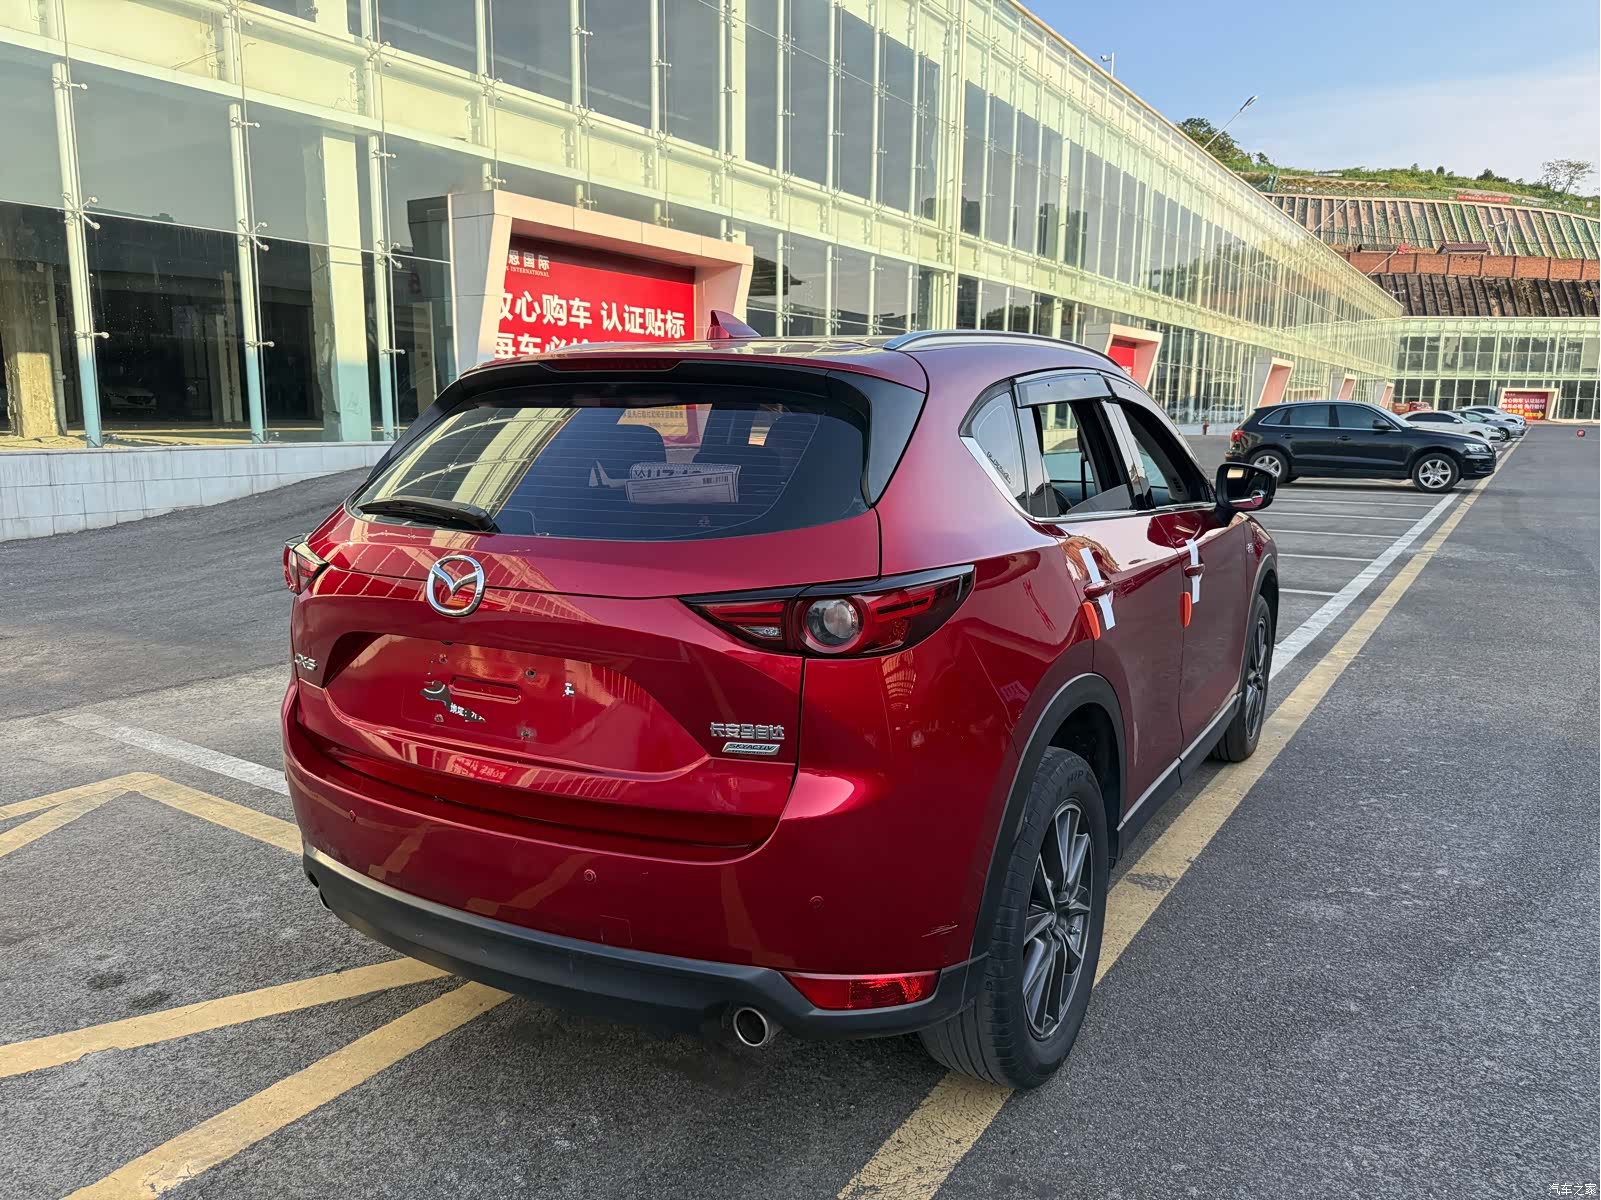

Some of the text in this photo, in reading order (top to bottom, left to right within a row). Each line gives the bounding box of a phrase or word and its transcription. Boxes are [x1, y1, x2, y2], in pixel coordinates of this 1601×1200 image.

[510, 266, 550, 278] INTERNATIONAL
[600, 301, 686, 339] 认证贴标
[709, 721, 785, 741] 长安马自达
[728, 743, 777, 751] SKYACTIV
